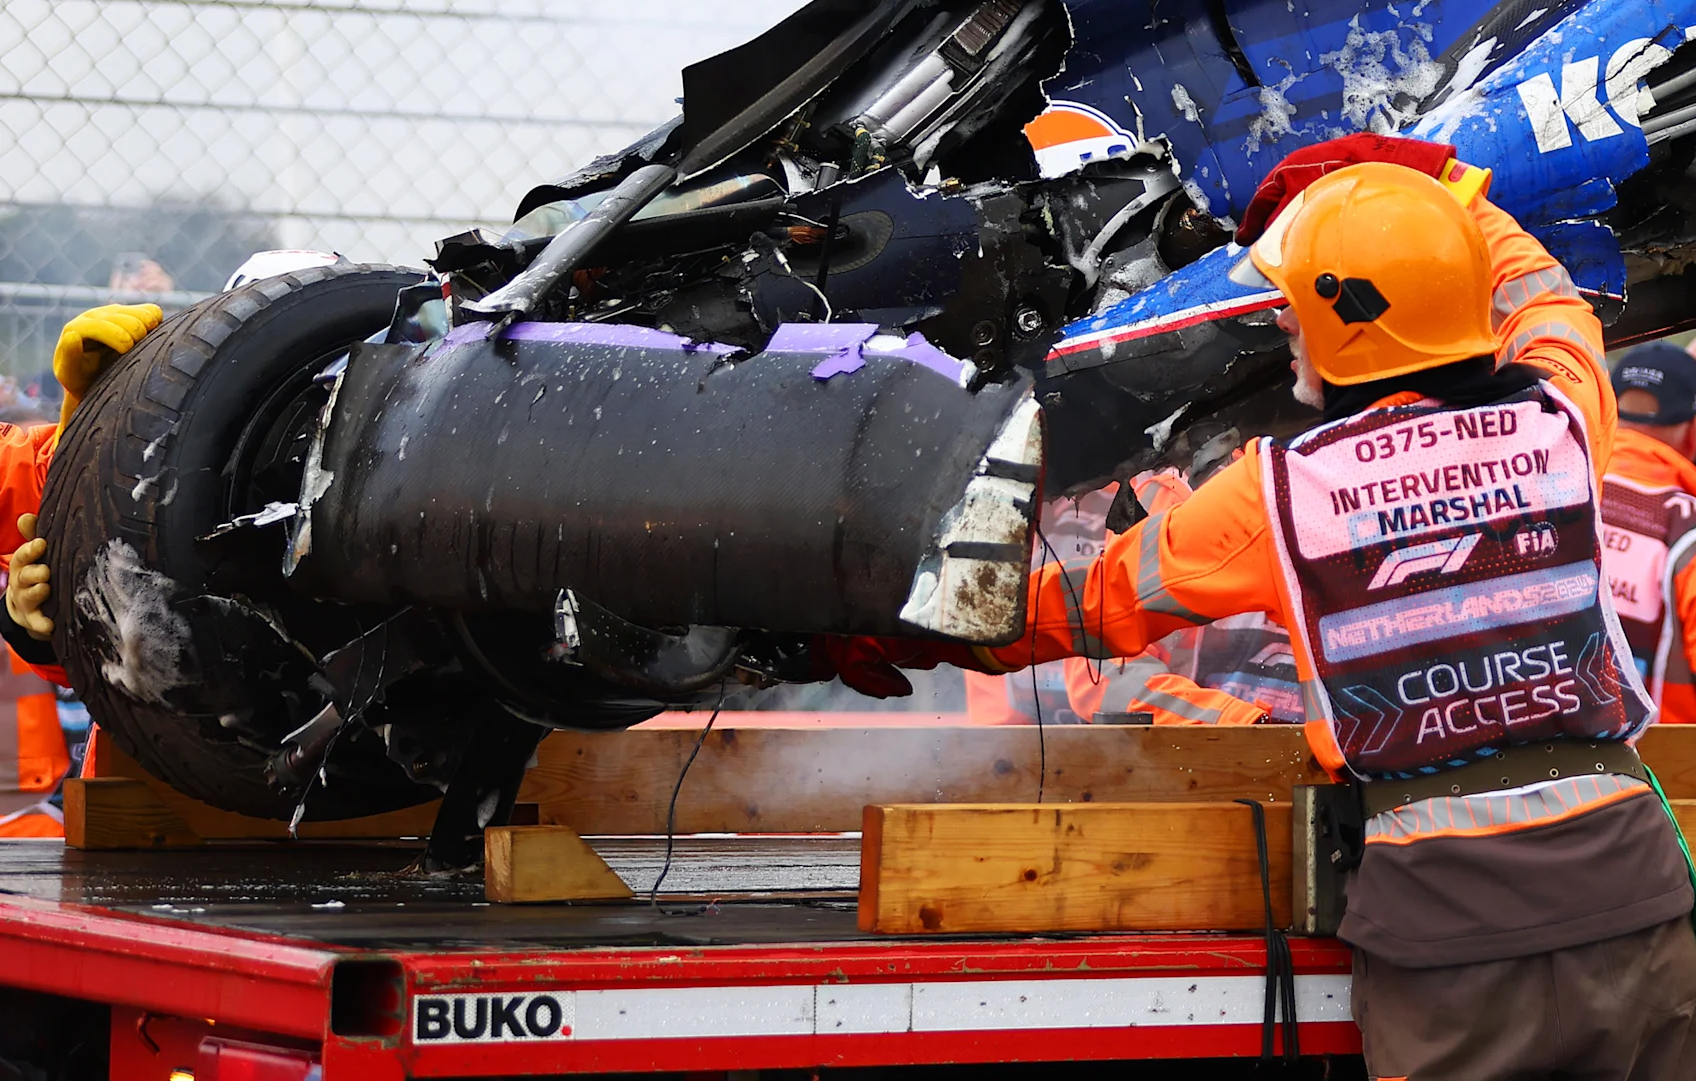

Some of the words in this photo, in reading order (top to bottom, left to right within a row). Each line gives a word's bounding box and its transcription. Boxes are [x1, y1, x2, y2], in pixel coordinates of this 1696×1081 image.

[1355, 409, 1518, 463] 0375-NED
[1331, 448, 1549, 515] INTERVENTION
[1379, 483, 1531, 537] MARSHAL
[1397, 641, 1573, 706] COURSE
[1416, 679, 1582, 744] ACCESS
